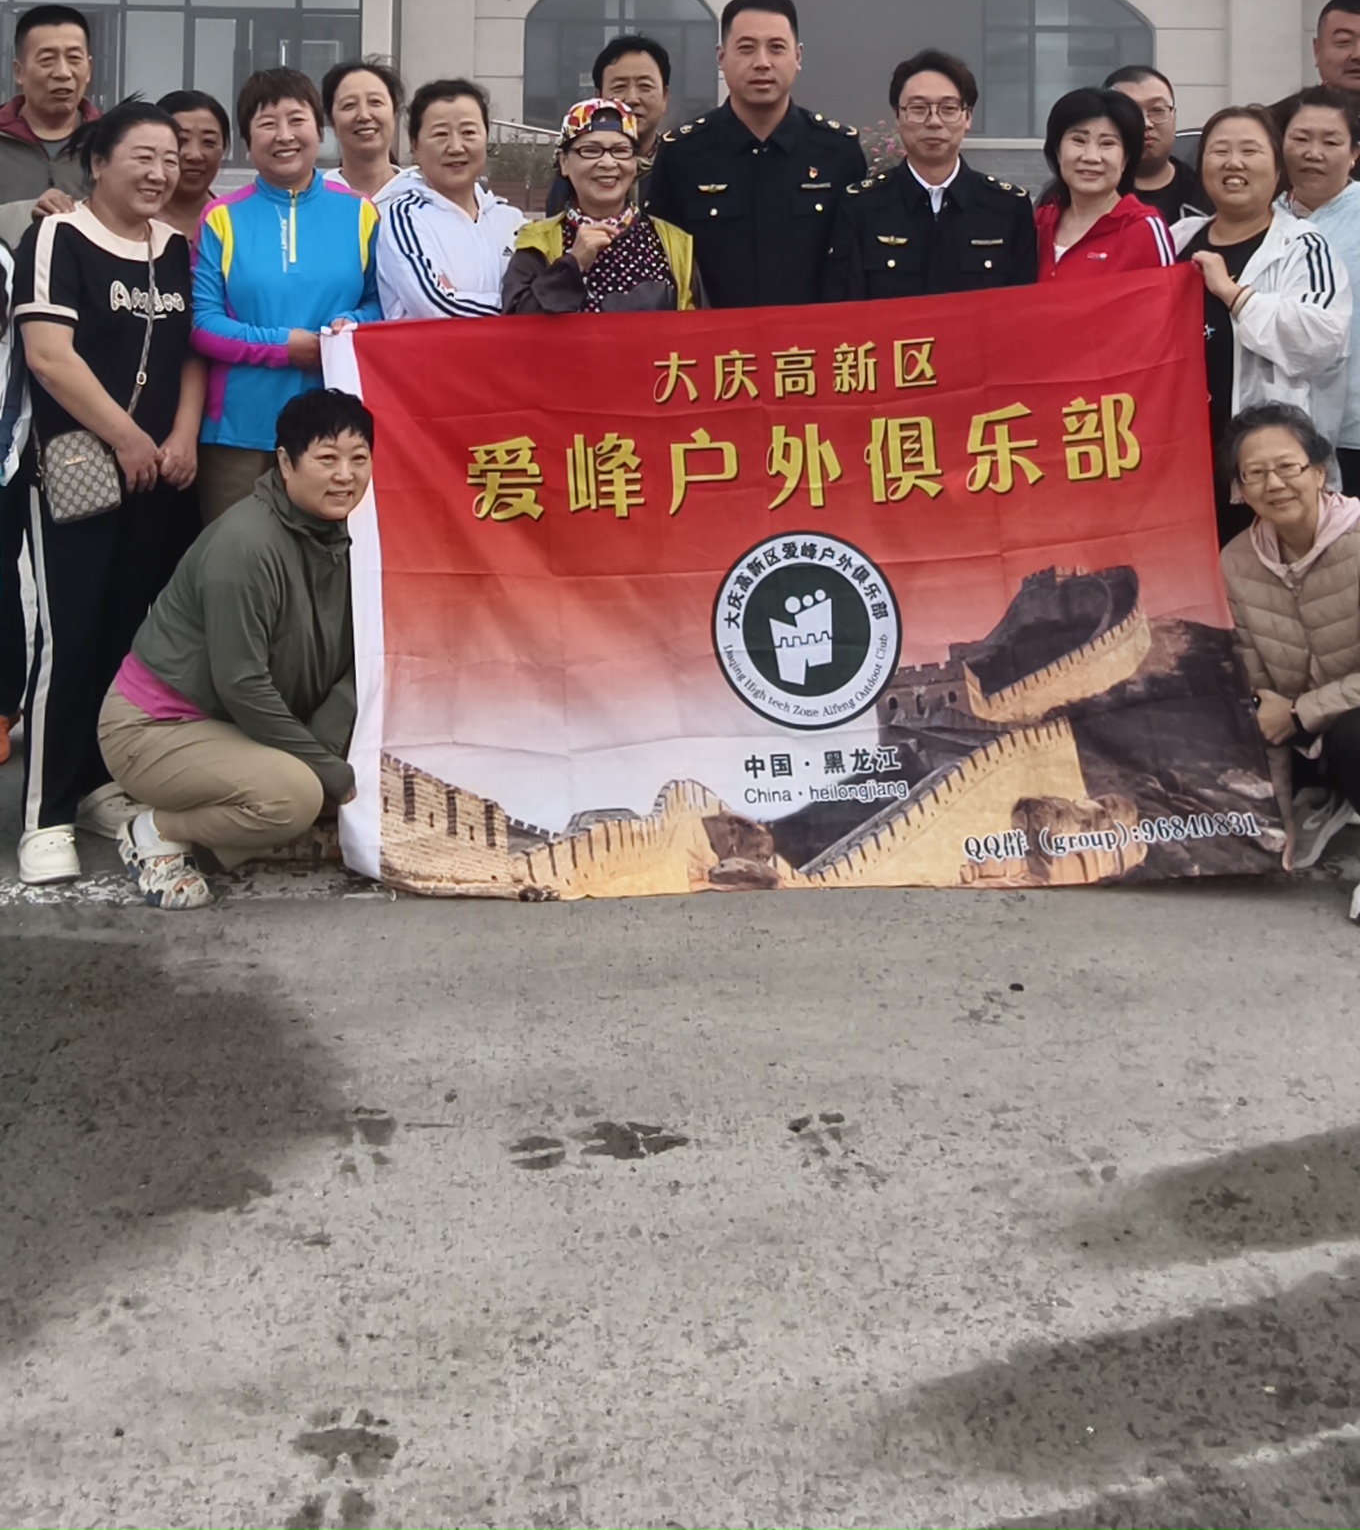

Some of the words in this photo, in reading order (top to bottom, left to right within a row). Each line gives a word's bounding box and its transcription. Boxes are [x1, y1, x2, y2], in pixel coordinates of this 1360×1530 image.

[654, 339, 937, 404] 大庆高新区
[465, 391, 1143, 523] 爱峰户外俱乐部
[723, 542, 889, 630] 大庆高新区爱峰户外俱乐部
